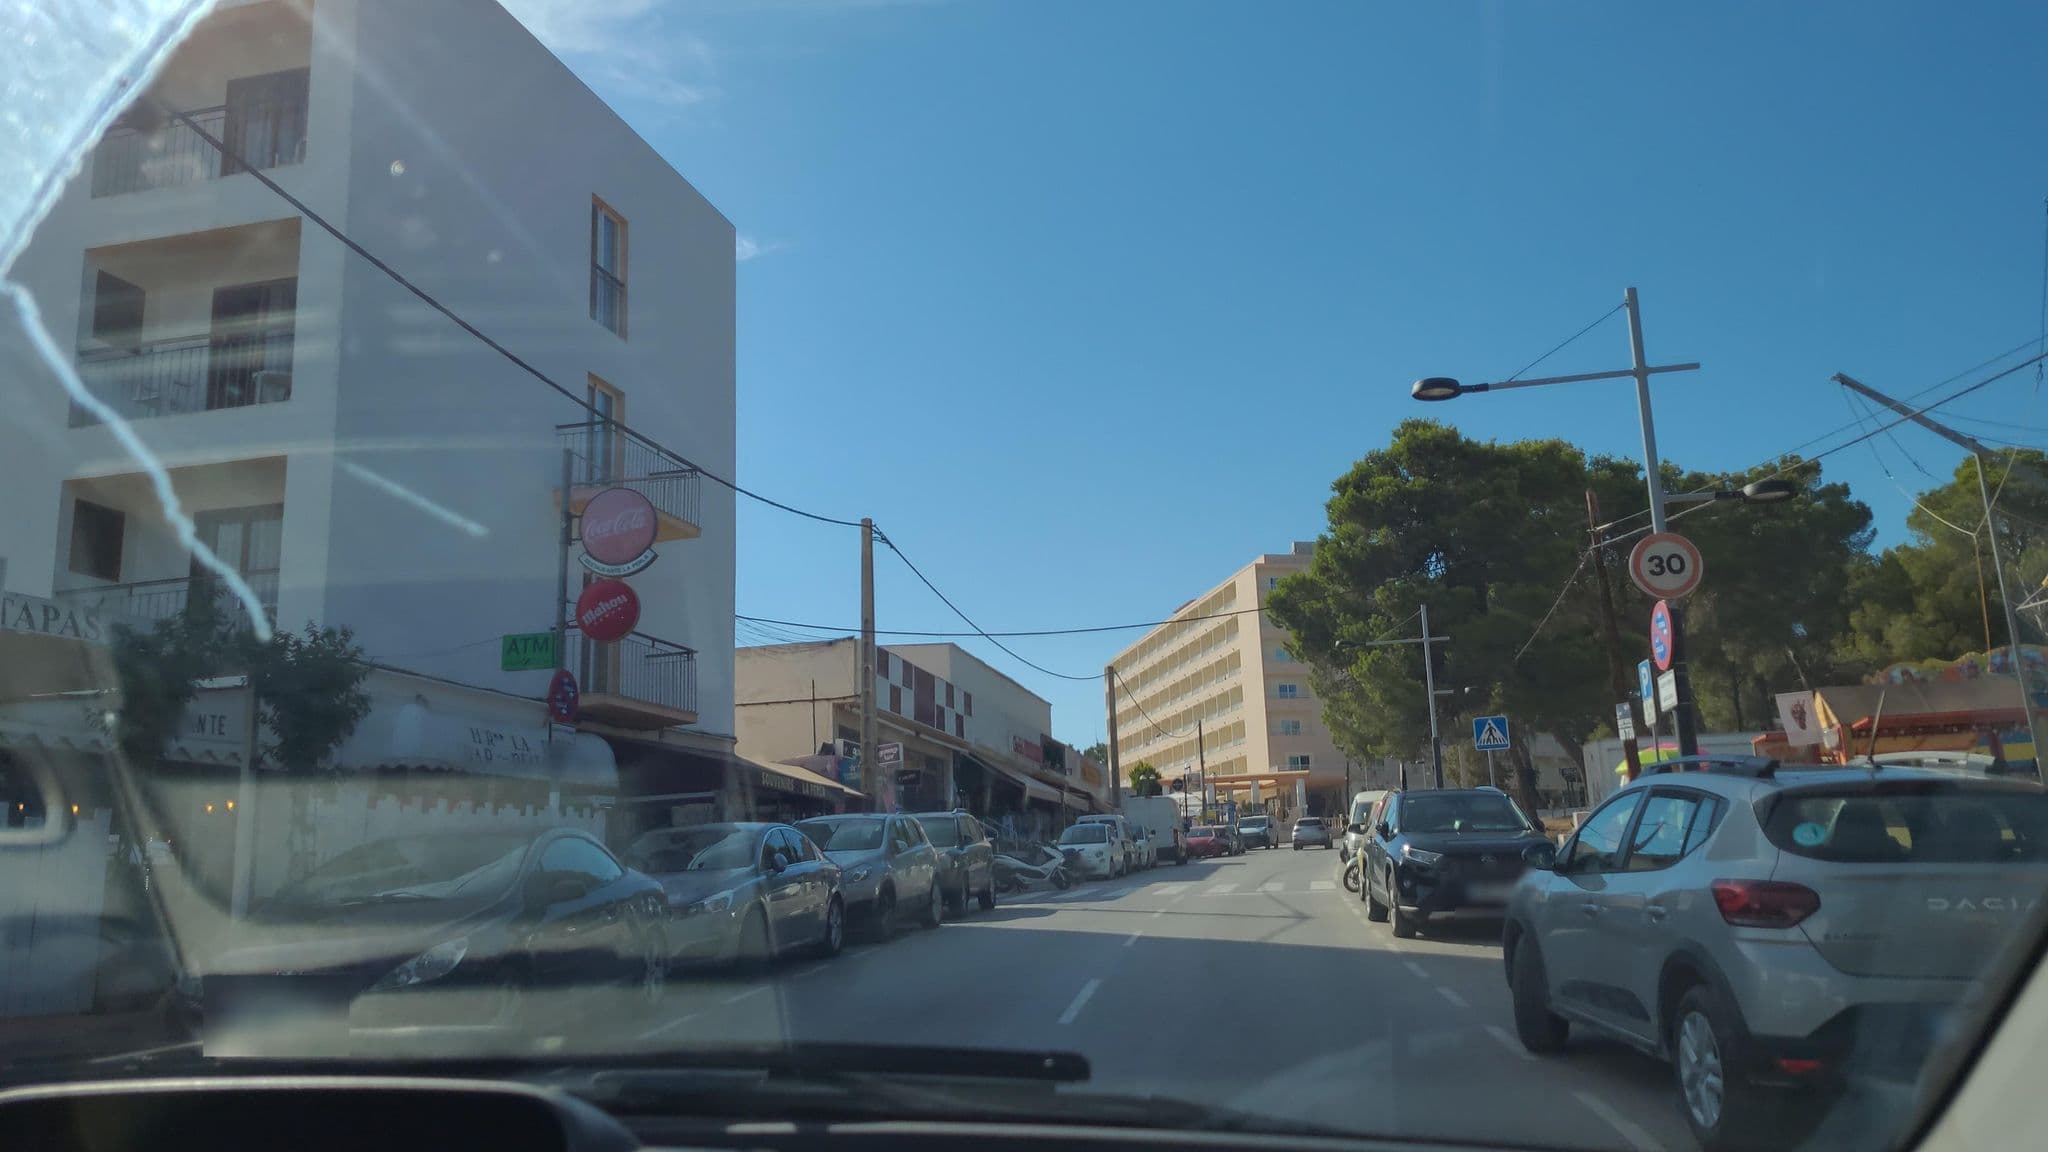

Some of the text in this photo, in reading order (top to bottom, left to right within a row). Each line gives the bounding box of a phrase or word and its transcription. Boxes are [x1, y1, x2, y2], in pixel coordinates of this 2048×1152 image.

[1648, 553, 1686, 577] 30
[582, 593, 629, 626] Mahou
[507, 636, 549, 656] ATM
